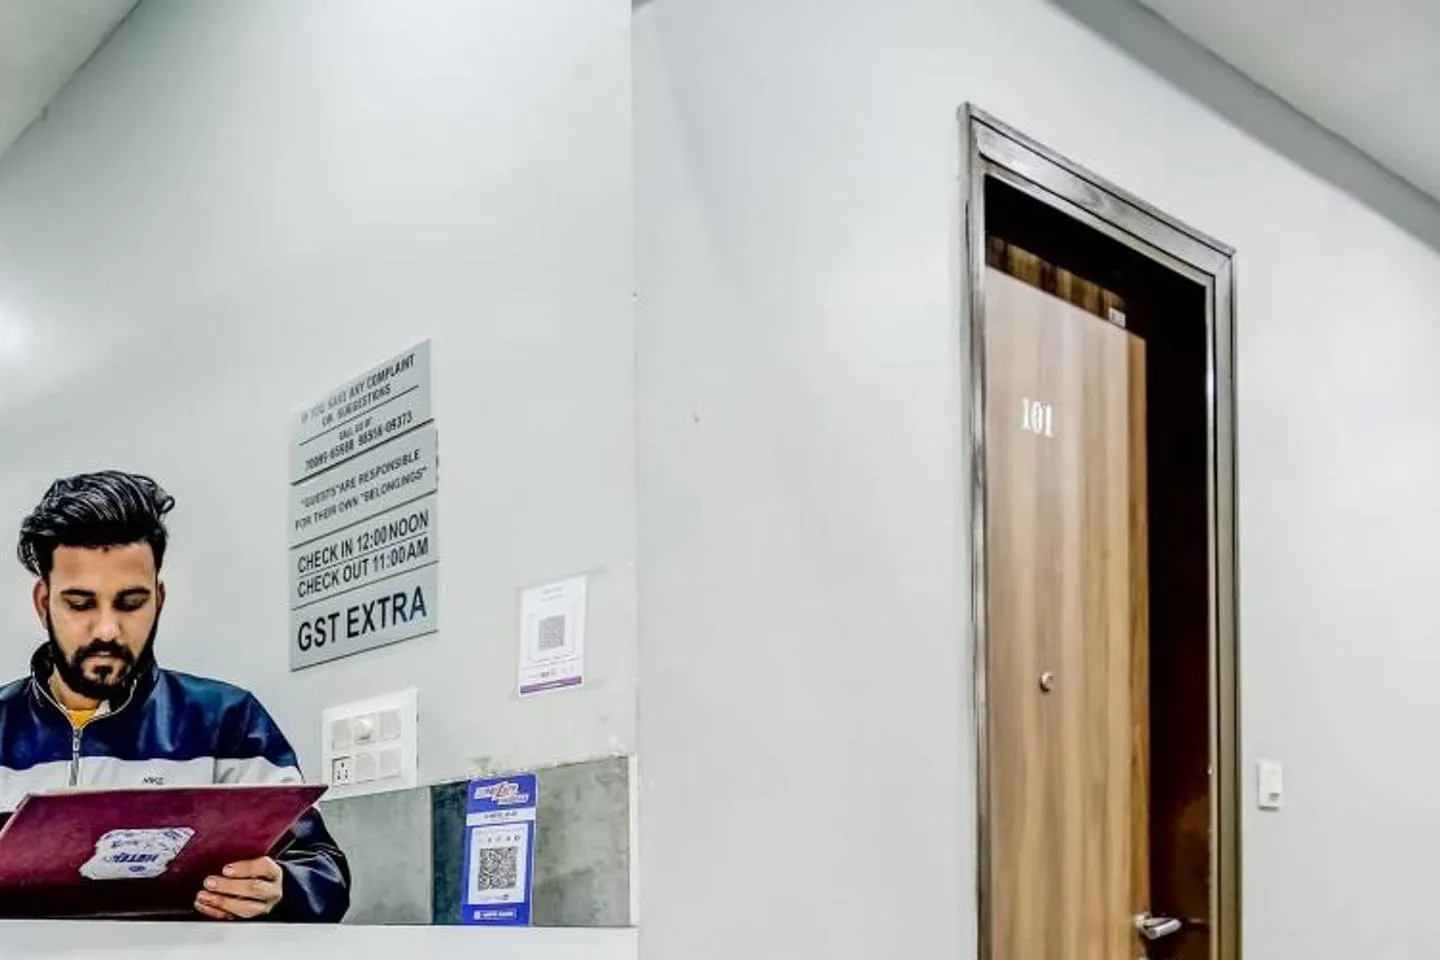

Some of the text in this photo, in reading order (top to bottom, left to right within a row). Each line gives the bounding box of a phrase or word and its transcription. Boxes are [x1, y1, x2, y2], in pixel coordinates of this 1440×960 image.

[349, 382, 365, 401] ANY
[366, 352, 416, 390] COMPLAINT
[322, 383, 392, 427] OR SUGGESTIONS
[1021, 397, 1055, 438] 101
[358, 448, 421, 484] RESPONSIBLE
[295, 515, 312, 531] FOR
[314, 505, 337, 523] THEIR
[338, 497, 359, 514] OWN
[297, 544, 339, 574] CHECK
[341, 538, 353, 558] IN
[297, 569, 340, 599] CHECK
[342, 558, 370, 583] OUT
[297, 584, 427, 652] GST EXTRA
